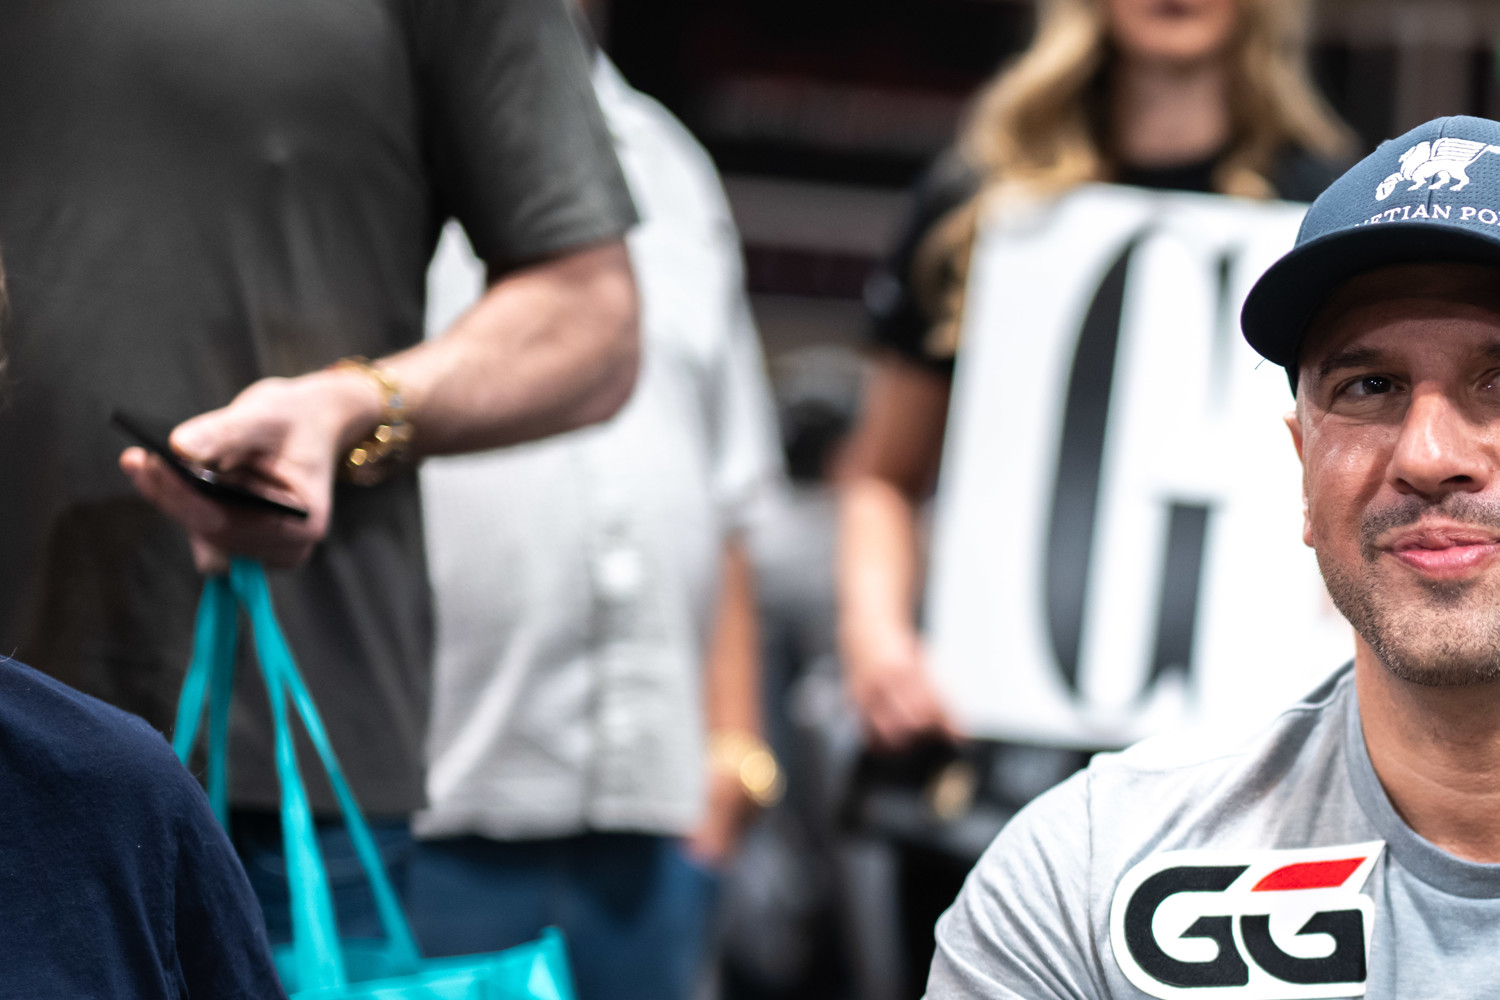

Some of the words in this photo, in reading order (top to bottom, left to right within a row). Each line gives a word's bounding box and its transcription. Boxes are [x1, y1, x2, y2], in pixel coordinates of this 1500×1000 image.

[1354, 204, 1451, 225] ETIAN
[1040, 216, 1240, 715] G
[1123, 856, 1368, 989] GG
